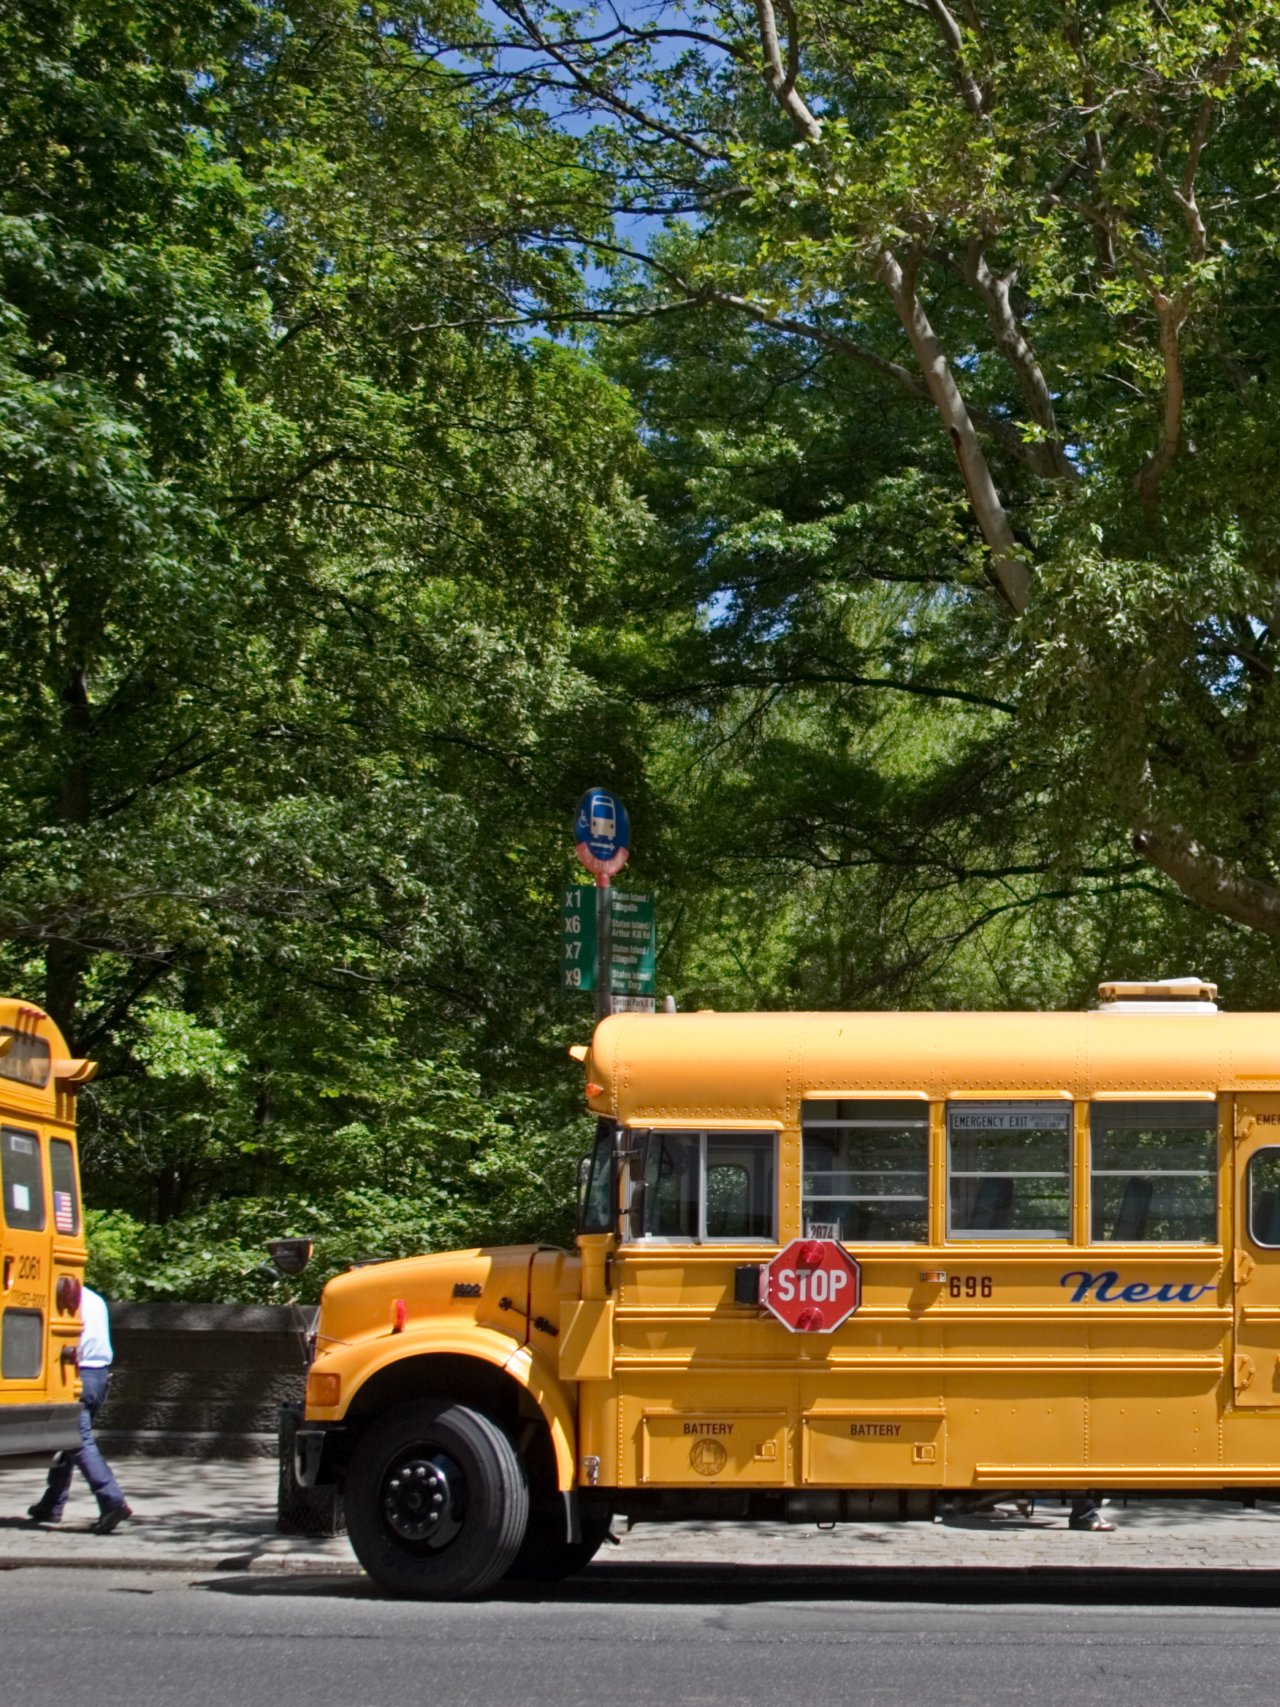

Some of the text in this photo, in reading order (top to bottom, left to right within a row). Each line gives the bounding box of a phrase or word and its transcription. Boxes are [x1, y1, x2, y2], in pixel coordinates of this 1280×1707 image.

[583, 846, 626, 870] NO STANDING
[612, 891, 630, 900] Staten
[611, 919, 630, 928] Staten
[611, 928, 651, 939] Arthur Kill Rd
[612, 943, 629, 953] Staten
[612, 969, 631, 979] Staten
[612, 979, 642, 990] New Dorp
[612, 996, 632, 1006] Central
[632, 998, 644, 1007] Park
[954, 1115, 1028, 1127] EMERGENCY EXIT
[810, 1224, 834, 1239] 2074
[18, 1254, 41, 1280] 2061
[778, 1268, 847, 1302] STOP
[950, 1276, 992, 1298] 696
[1060, 1270, 1219, 1303] New
[683, 1423, 734, 1435] BATTERY
[850, 1424, 901, 1436] BATTERY
